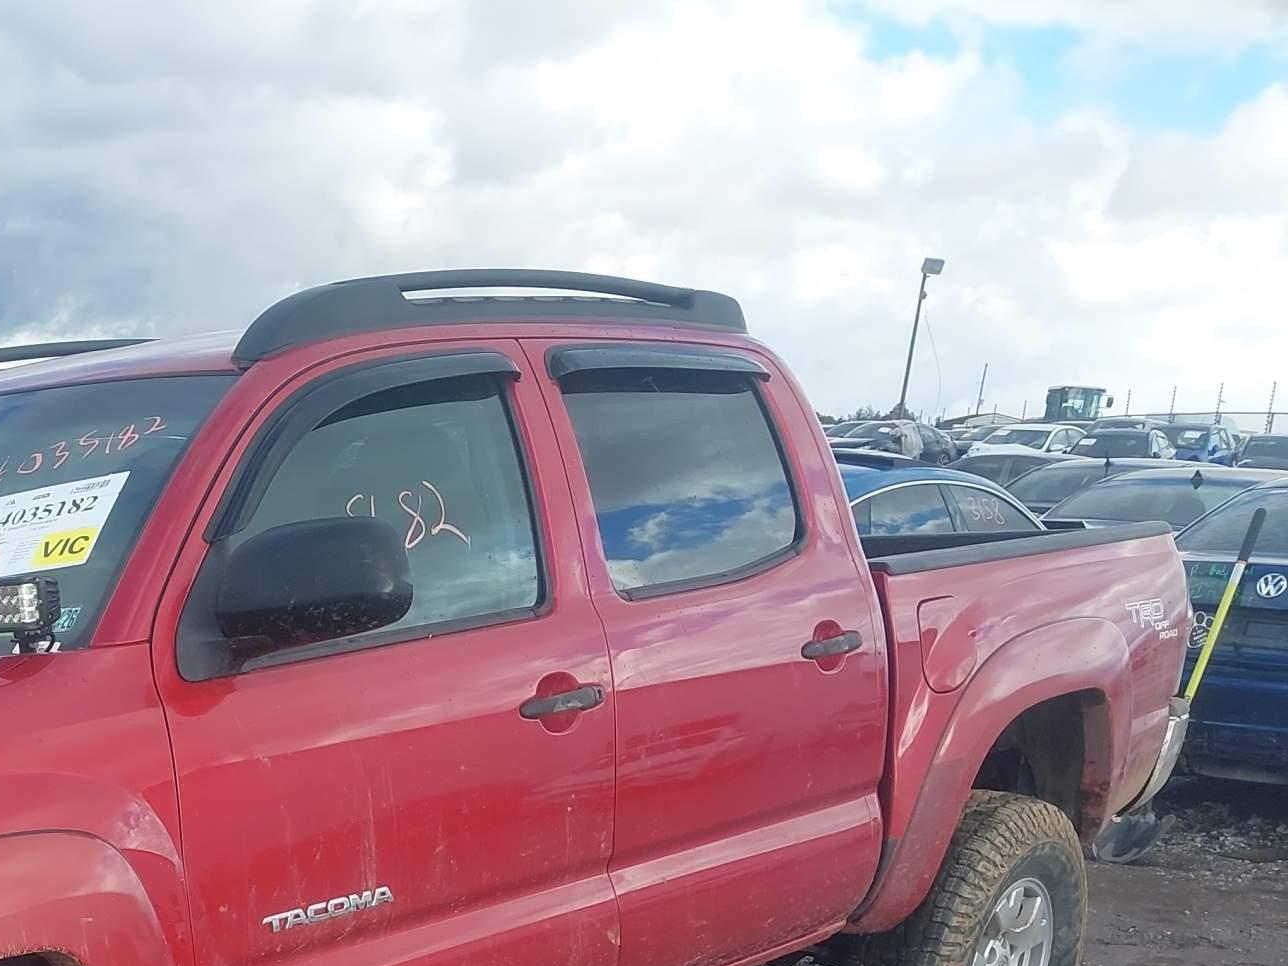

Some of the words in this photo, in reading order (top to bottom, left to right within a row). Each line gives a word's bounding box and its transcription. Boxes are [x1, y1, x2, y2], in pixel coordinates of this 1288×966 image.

[43, 535, 90, 558] VIC
[1125, 598, 1164, 628] TRD
[1154, 619, 1169, 631] OFF
[1159, 628, 1178, 641] ROAD
[262, 886, 394, 933] TACOMA
